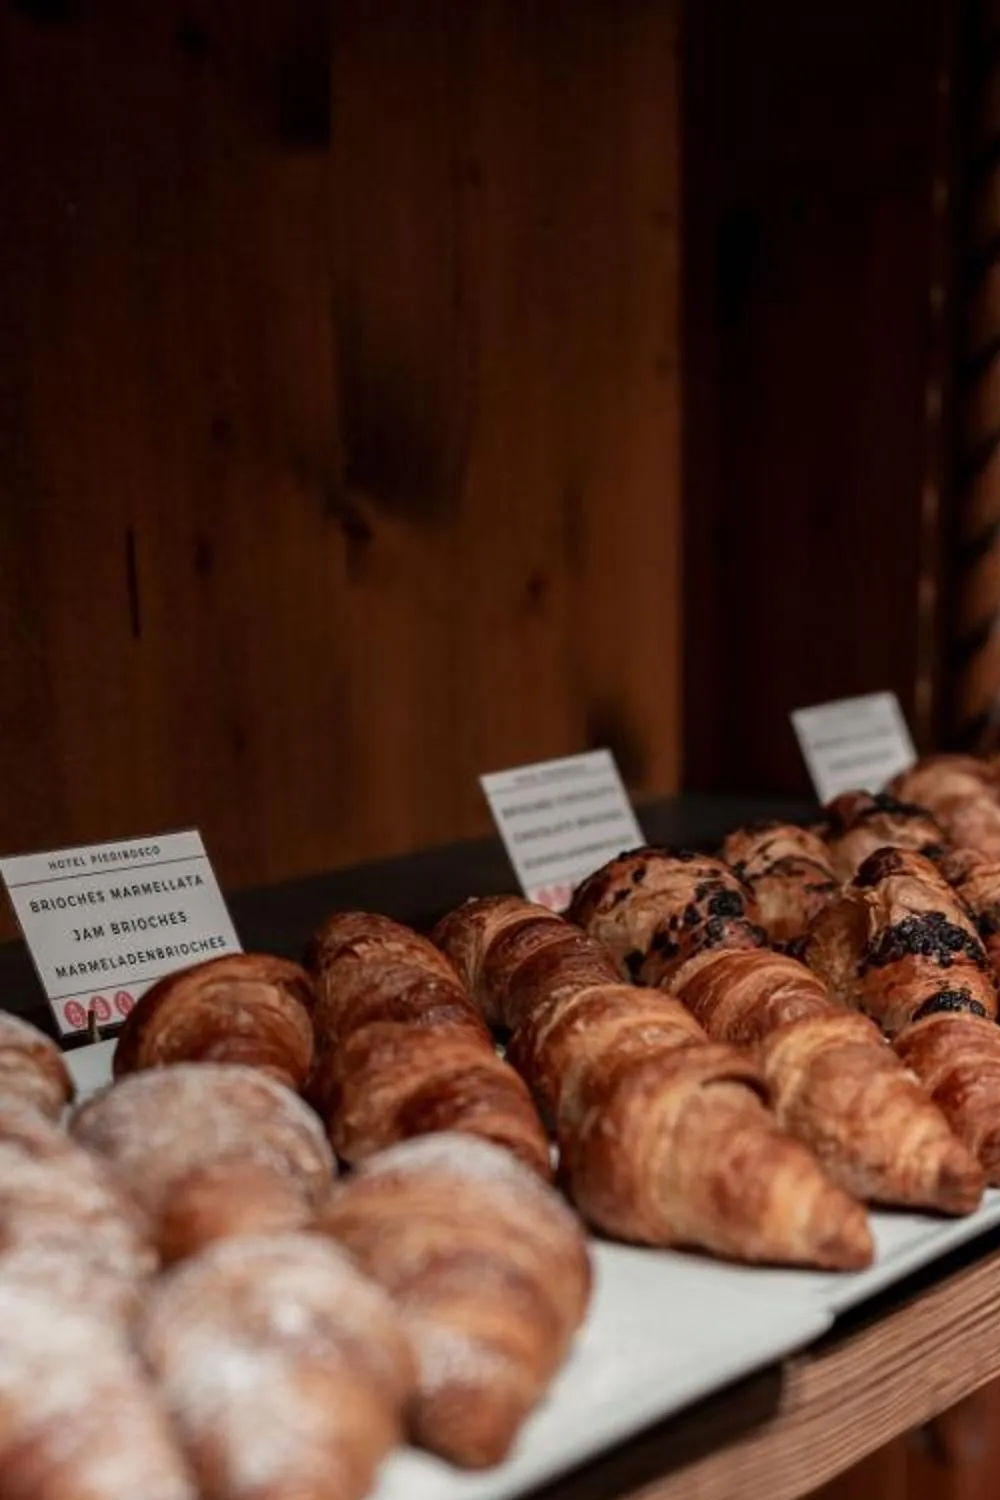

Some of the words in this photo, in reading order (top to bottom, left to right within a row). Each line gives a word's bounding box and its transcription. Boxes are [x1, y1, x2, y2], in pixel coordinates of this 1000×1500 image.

[29, 891, 105, 913] BRIOCHES
[109, 875, 203, 899] MARMELLATA
[72, 926, 105, 940] JAM
[111, 912, 187, 934] BRIOCHES
[55, 936, 225, 978] MARMELADENBRIOCHES
